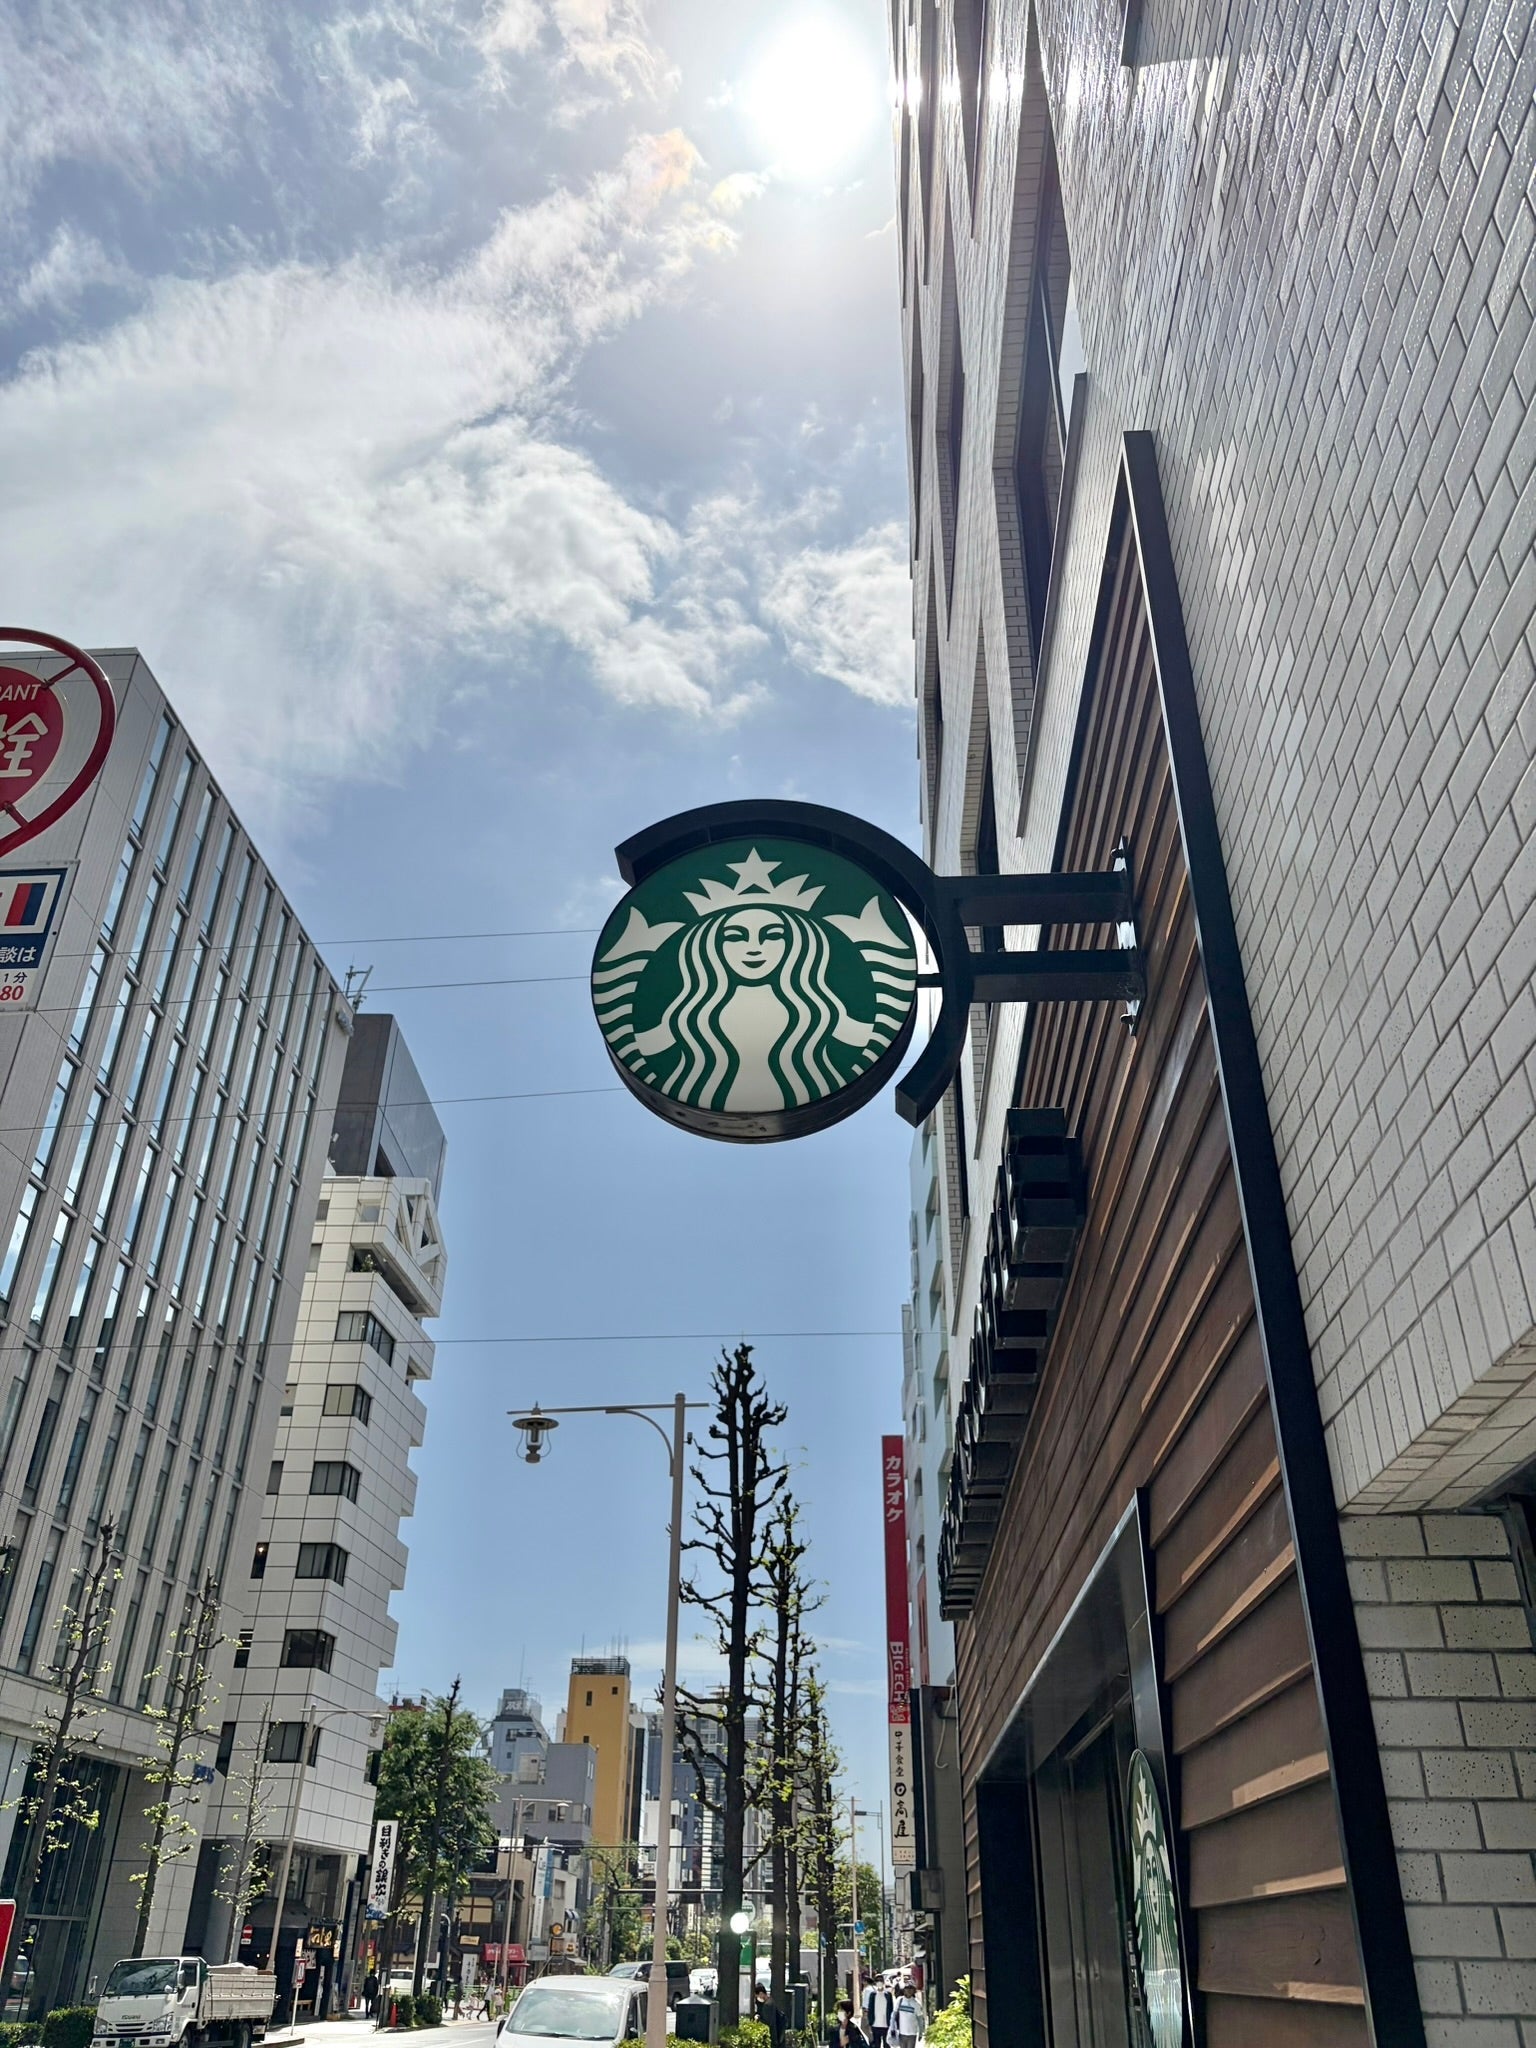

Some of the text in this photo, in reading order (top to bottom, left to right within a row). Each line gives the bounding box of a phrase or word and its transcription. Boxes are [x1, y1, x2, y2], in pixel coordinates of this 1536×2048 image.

[0, 684, 41, 701] ANT
[0, 985, 24, 1001] 80
[886, 1455, 903, 1523] カラオケ
[889, 1641, 904, 1671] BIG
